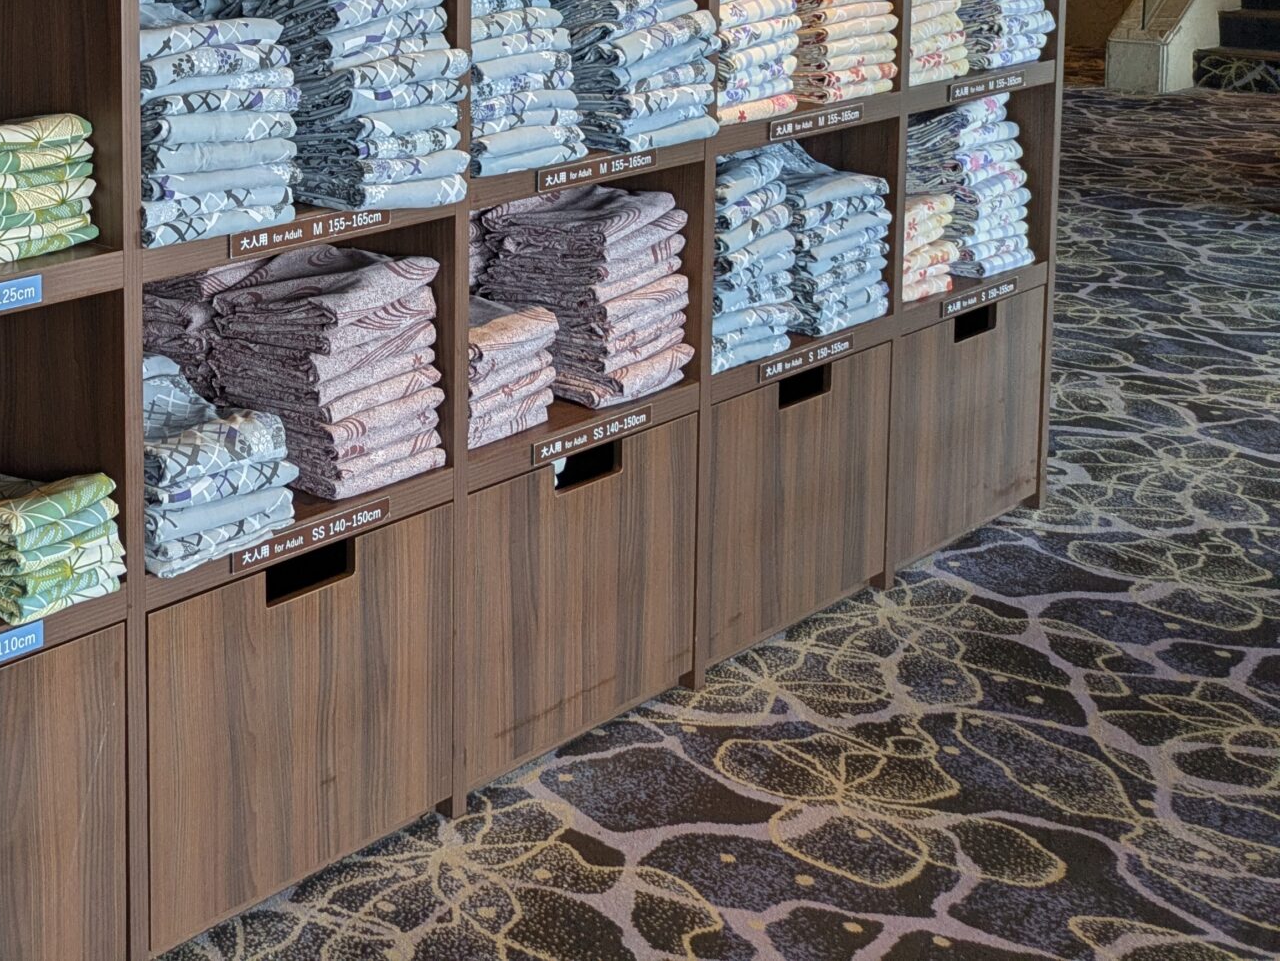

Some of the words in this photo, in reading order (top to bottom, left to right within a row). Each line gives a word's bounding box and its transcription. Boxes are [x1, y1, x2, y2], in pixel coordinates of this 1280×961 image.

[988, 80, 994, 90] M
[776, 123, 793, 136] 大人用
[818, 116, 825, 126] M
[545, 171, 567, 187] 大人用
[569, 171, 578, 179] for
[578, 167, 593, 178] Adult
[600, 162, 607, 174] M
[240, 232, 268, 251] 大人用
[273, 233, 283, 243] for
[284, 229, 303, 241] Adult
[313, 221, 323, 236] M
[981, 291, 986, 301] S
[766, 362, 783, 377] 大人用
[808, 352, 814, 363] S
[540, 440, 562, 459] 大人用
[573, 434, 588, 446] Adult
[593, 426, 604, 440] SS
[242, 544, 270, 566] 大人用
[274, 542, 284, 553] for
[285, 536, 304, 550] Adult
[312, 526, 325, 541] SS
